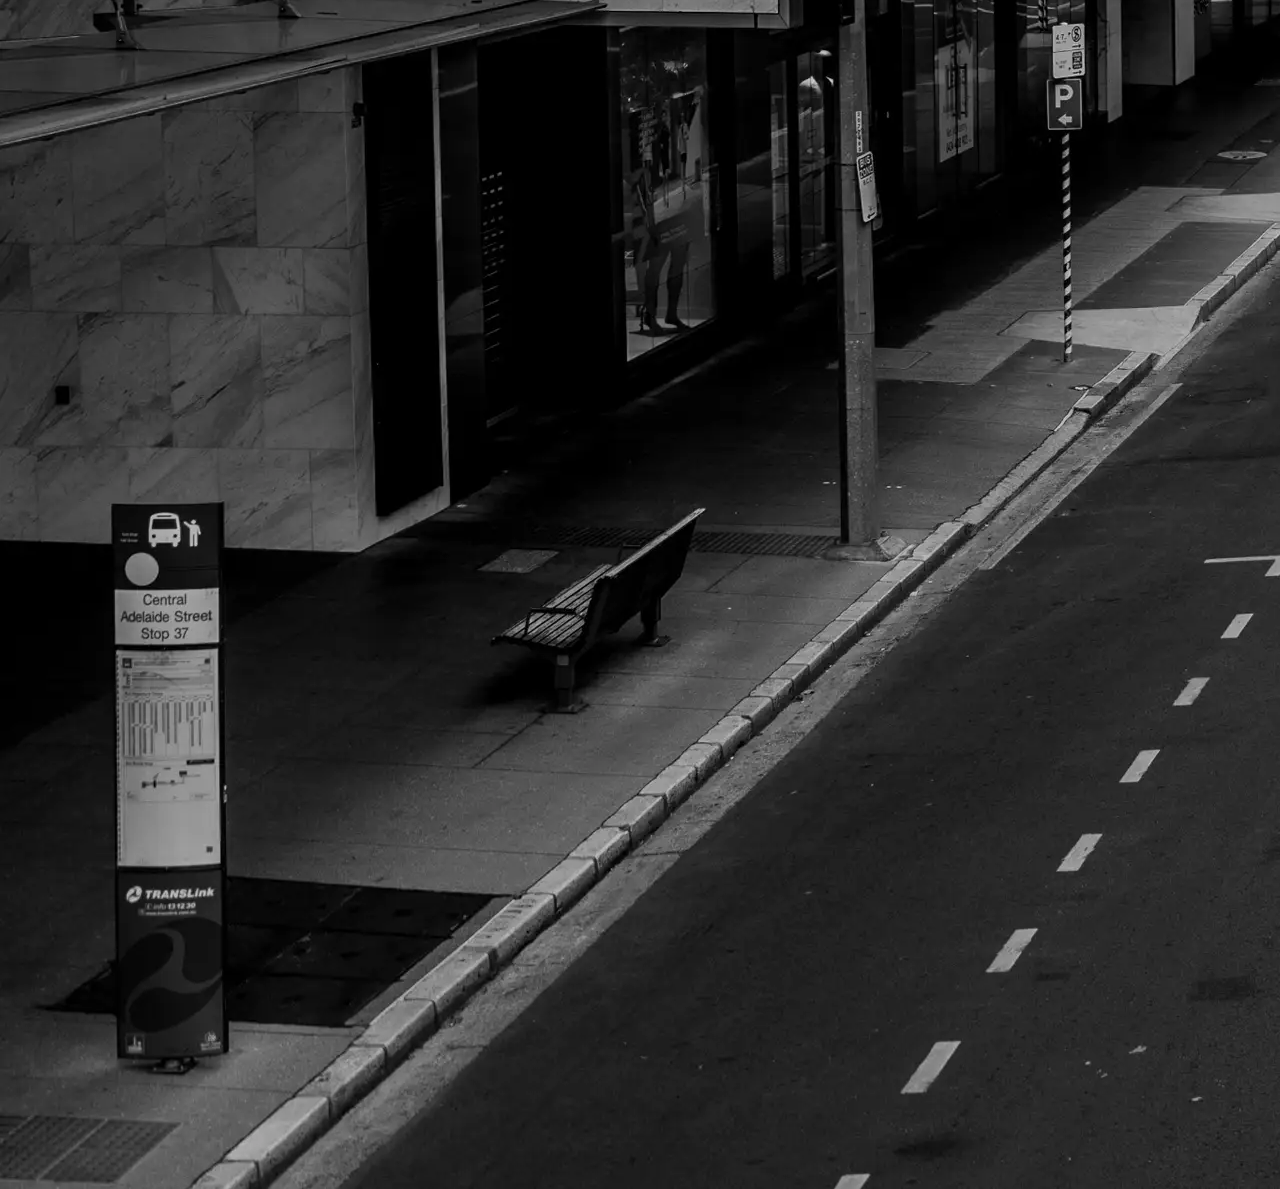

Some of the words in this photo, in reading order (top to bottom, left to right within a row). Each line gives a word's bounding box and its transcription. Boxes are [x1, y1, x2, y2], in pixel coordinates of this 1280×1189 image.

[1055, 84, 1074, 109] P
[142, 593, 187, 606] Central
[120, 610, 170, 623] Adelaide
[174, 609, 213, 622] Street
[141, 627, 170, 642] Stop
[174, 627, 189, 640] 37
